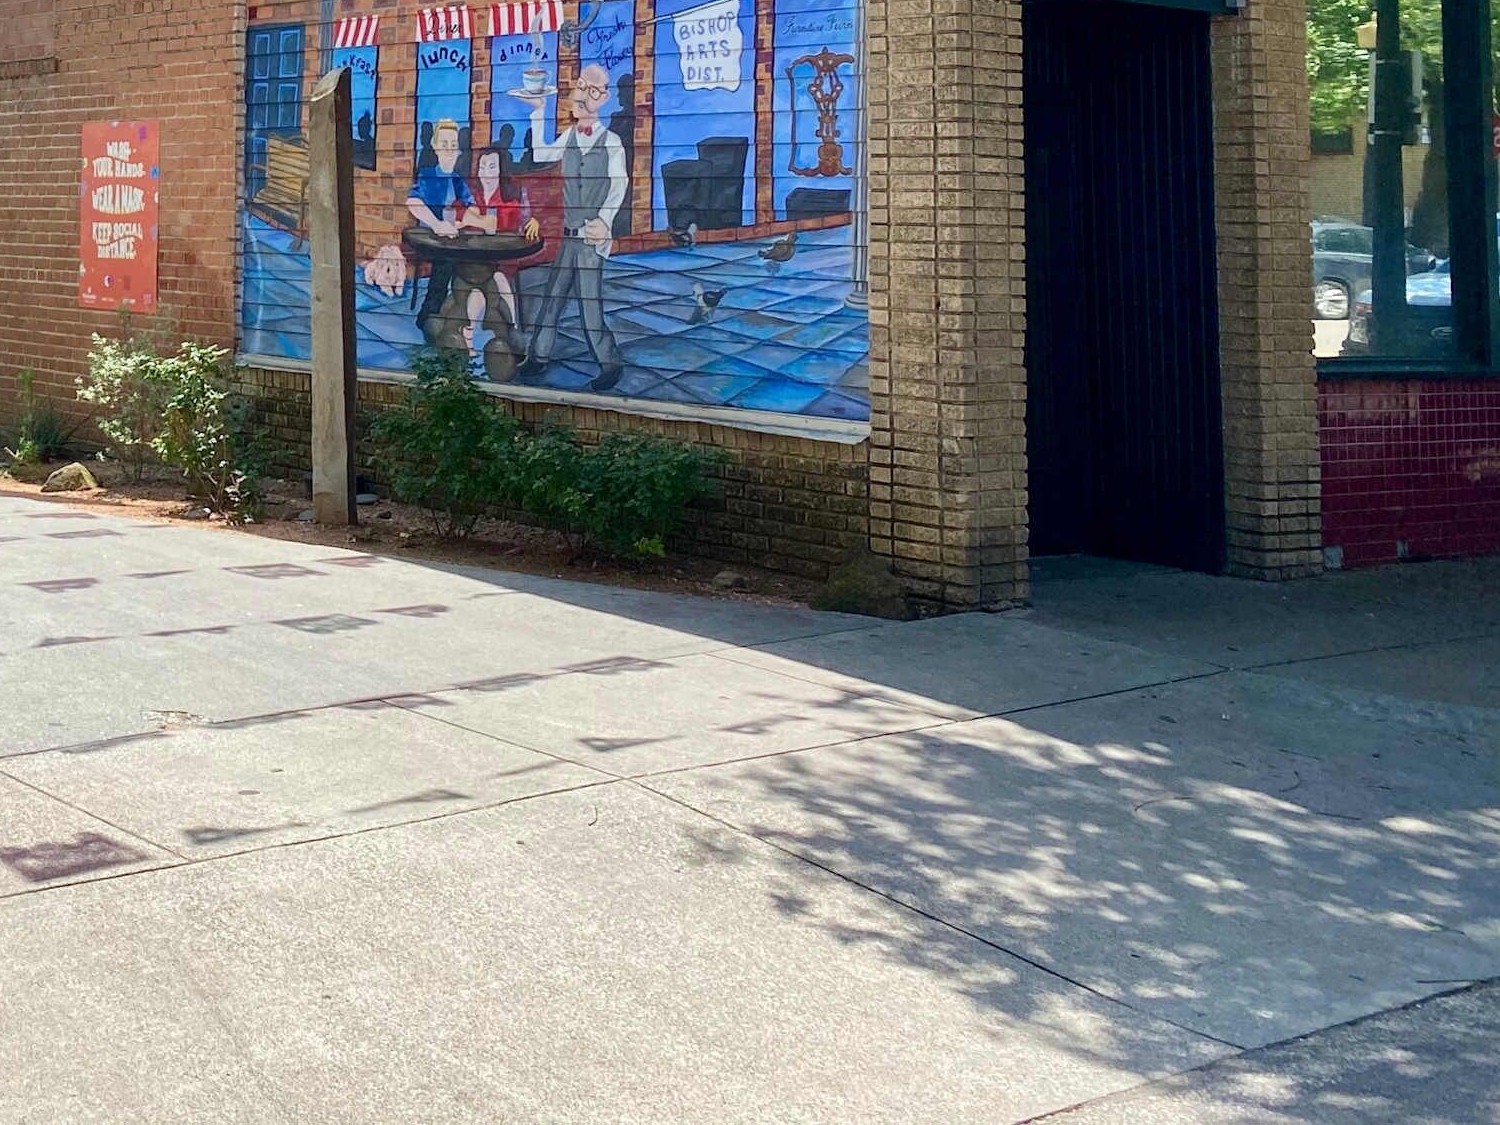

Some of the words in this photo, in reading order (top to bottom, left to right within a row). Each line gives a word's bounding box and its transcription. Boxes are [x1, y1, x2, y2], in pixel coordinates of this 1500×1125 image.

[678, 12, 736, 40] BISHOP
[421, 46, 467, 73] lunch
[499, 42, 549, 62] dinner
[685, 40, 731, 59] ARTS
[687, 66, 725, 82] DIST.
[93, 157, 114, 178] YOUR
[92, 185, 114, 213] WEAR
[92, 222, 112, 244] KEEP
[113, 222, 143, 241] SOCIAL
